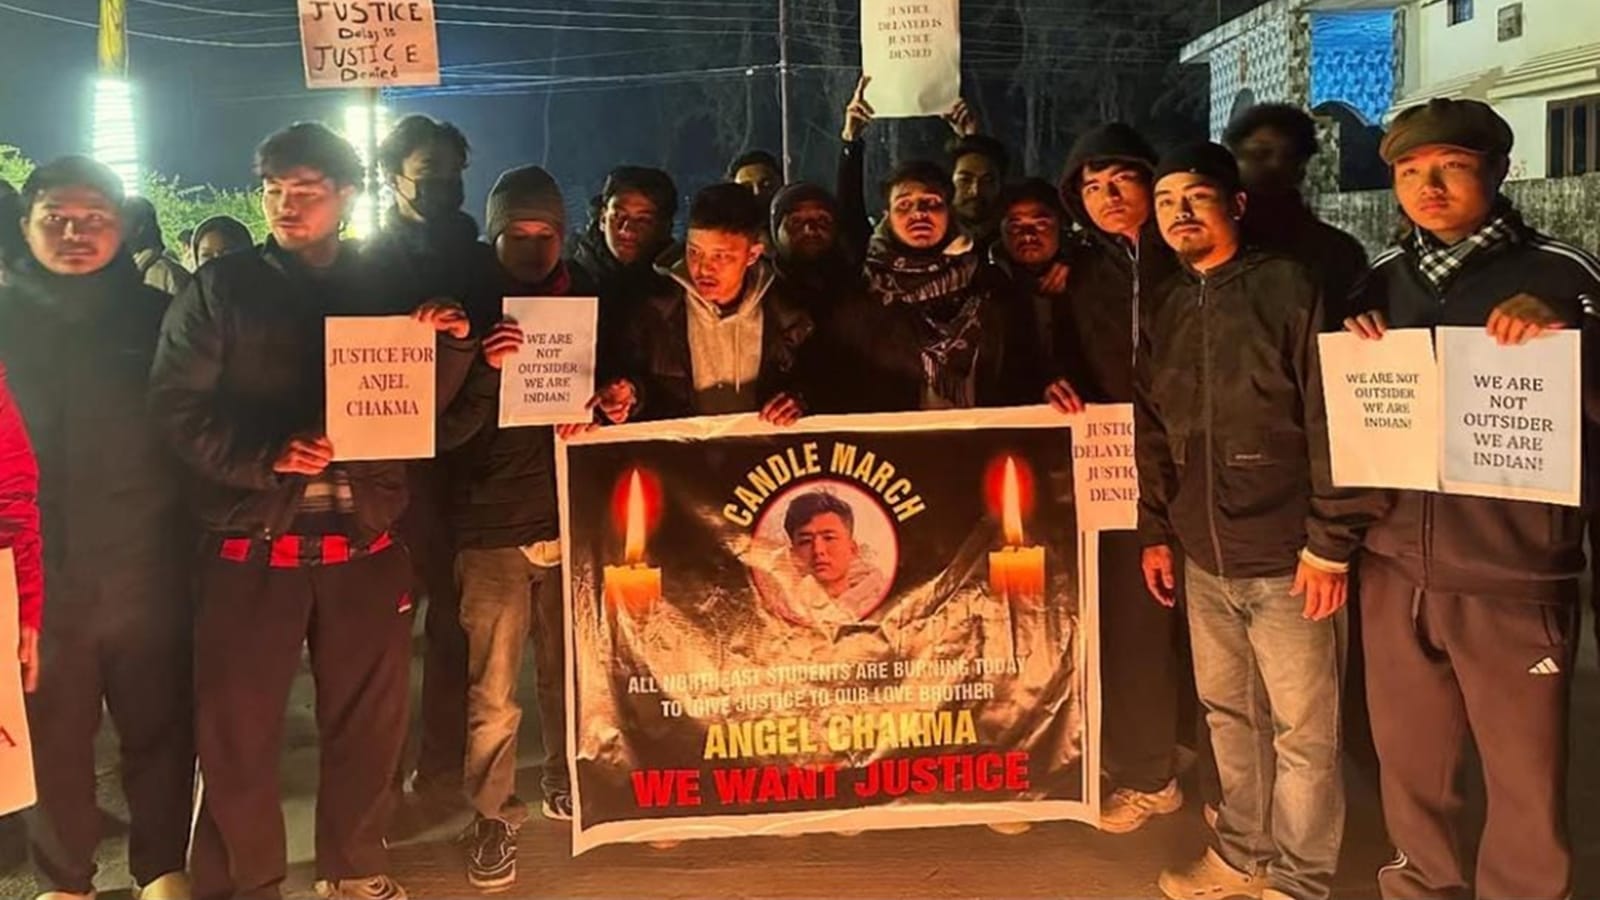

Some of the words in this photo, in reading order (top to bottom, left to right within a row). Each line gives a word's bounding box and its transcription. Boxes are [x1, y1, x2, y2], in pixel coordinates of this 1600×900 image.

[309, 2, 423, 24] JUSTICE
[878, 20, 930, 30] DELAYED
[932, 18, 942, 28] IS
[313, 43, 419, 70] JUSTICE
[889, 49, 931, 59] DENIED
[341, 65, 397, 82] Denied
[526, 334, 546, 345] WE
[548, 333, 573, 345] ARE
[329, 346, 398, 368] JUSTICE
[401, 346, 433, 363] FOR
[536, 348, 562, 359] NOT
[518, 362, 578, 375] OUTSIDER
[1345, 372, 1367, 384] WE
[1369, 371, 1393, 384] ARE
[1396, 373, 1419, 384] NOT
[358, 373, 410, 392] ANJEL
[524, 377, 544, 389] WE
[546, 376, 571, 389] ARE
[1473, 374, 1502, 389] WE
[1506, 376, 1544, 392] ARE
[523, 391, 570, 404] INDIAN!
[1354, 387, 1415, 399] OUTSIDER
[1489, 394, 1528, 410] NOT
[346, 399, 419, 417] CHAKMA
[1363, 402, 1384, 414] WE
[1386, 402, 1410, 414] ARE
[1364, 417, 1412, 429] INDIAN!
[1463, 412, 1553, 433] OUTSIDER
[1473, 432, 1502, 448] WE
[1506, 435, 1544, 451] ARE
[1473, 451, 1544, 471] INDIAN!
[723, 441, 821, 527] CANDLE
[829, 441, 926, 522] MARCH
[628, 675, 658, 694] ALL
[767, 663, 850, 683] STUDENTS
[856, 661, 888, 680] ARE
[974, 656, 1027, 675] TODAY
[661, 700, 682, 717] TO
[736, 691, 807, 712] JUSTICE
[811, 689, 829, 707] TO
[835, 686, 868, 705] OUR
[874, 685, 914, 702] LOVE
[919, 683, 995, 702] BROTHER
[704, 718, 817, 759] ANGEL
[828, 711, 977, 752] CHAKMA
[631, 770, 701, 807] WE
[713, 766, 839, 804] WANT
[855, 752, 1029, 797] JUSTICE
